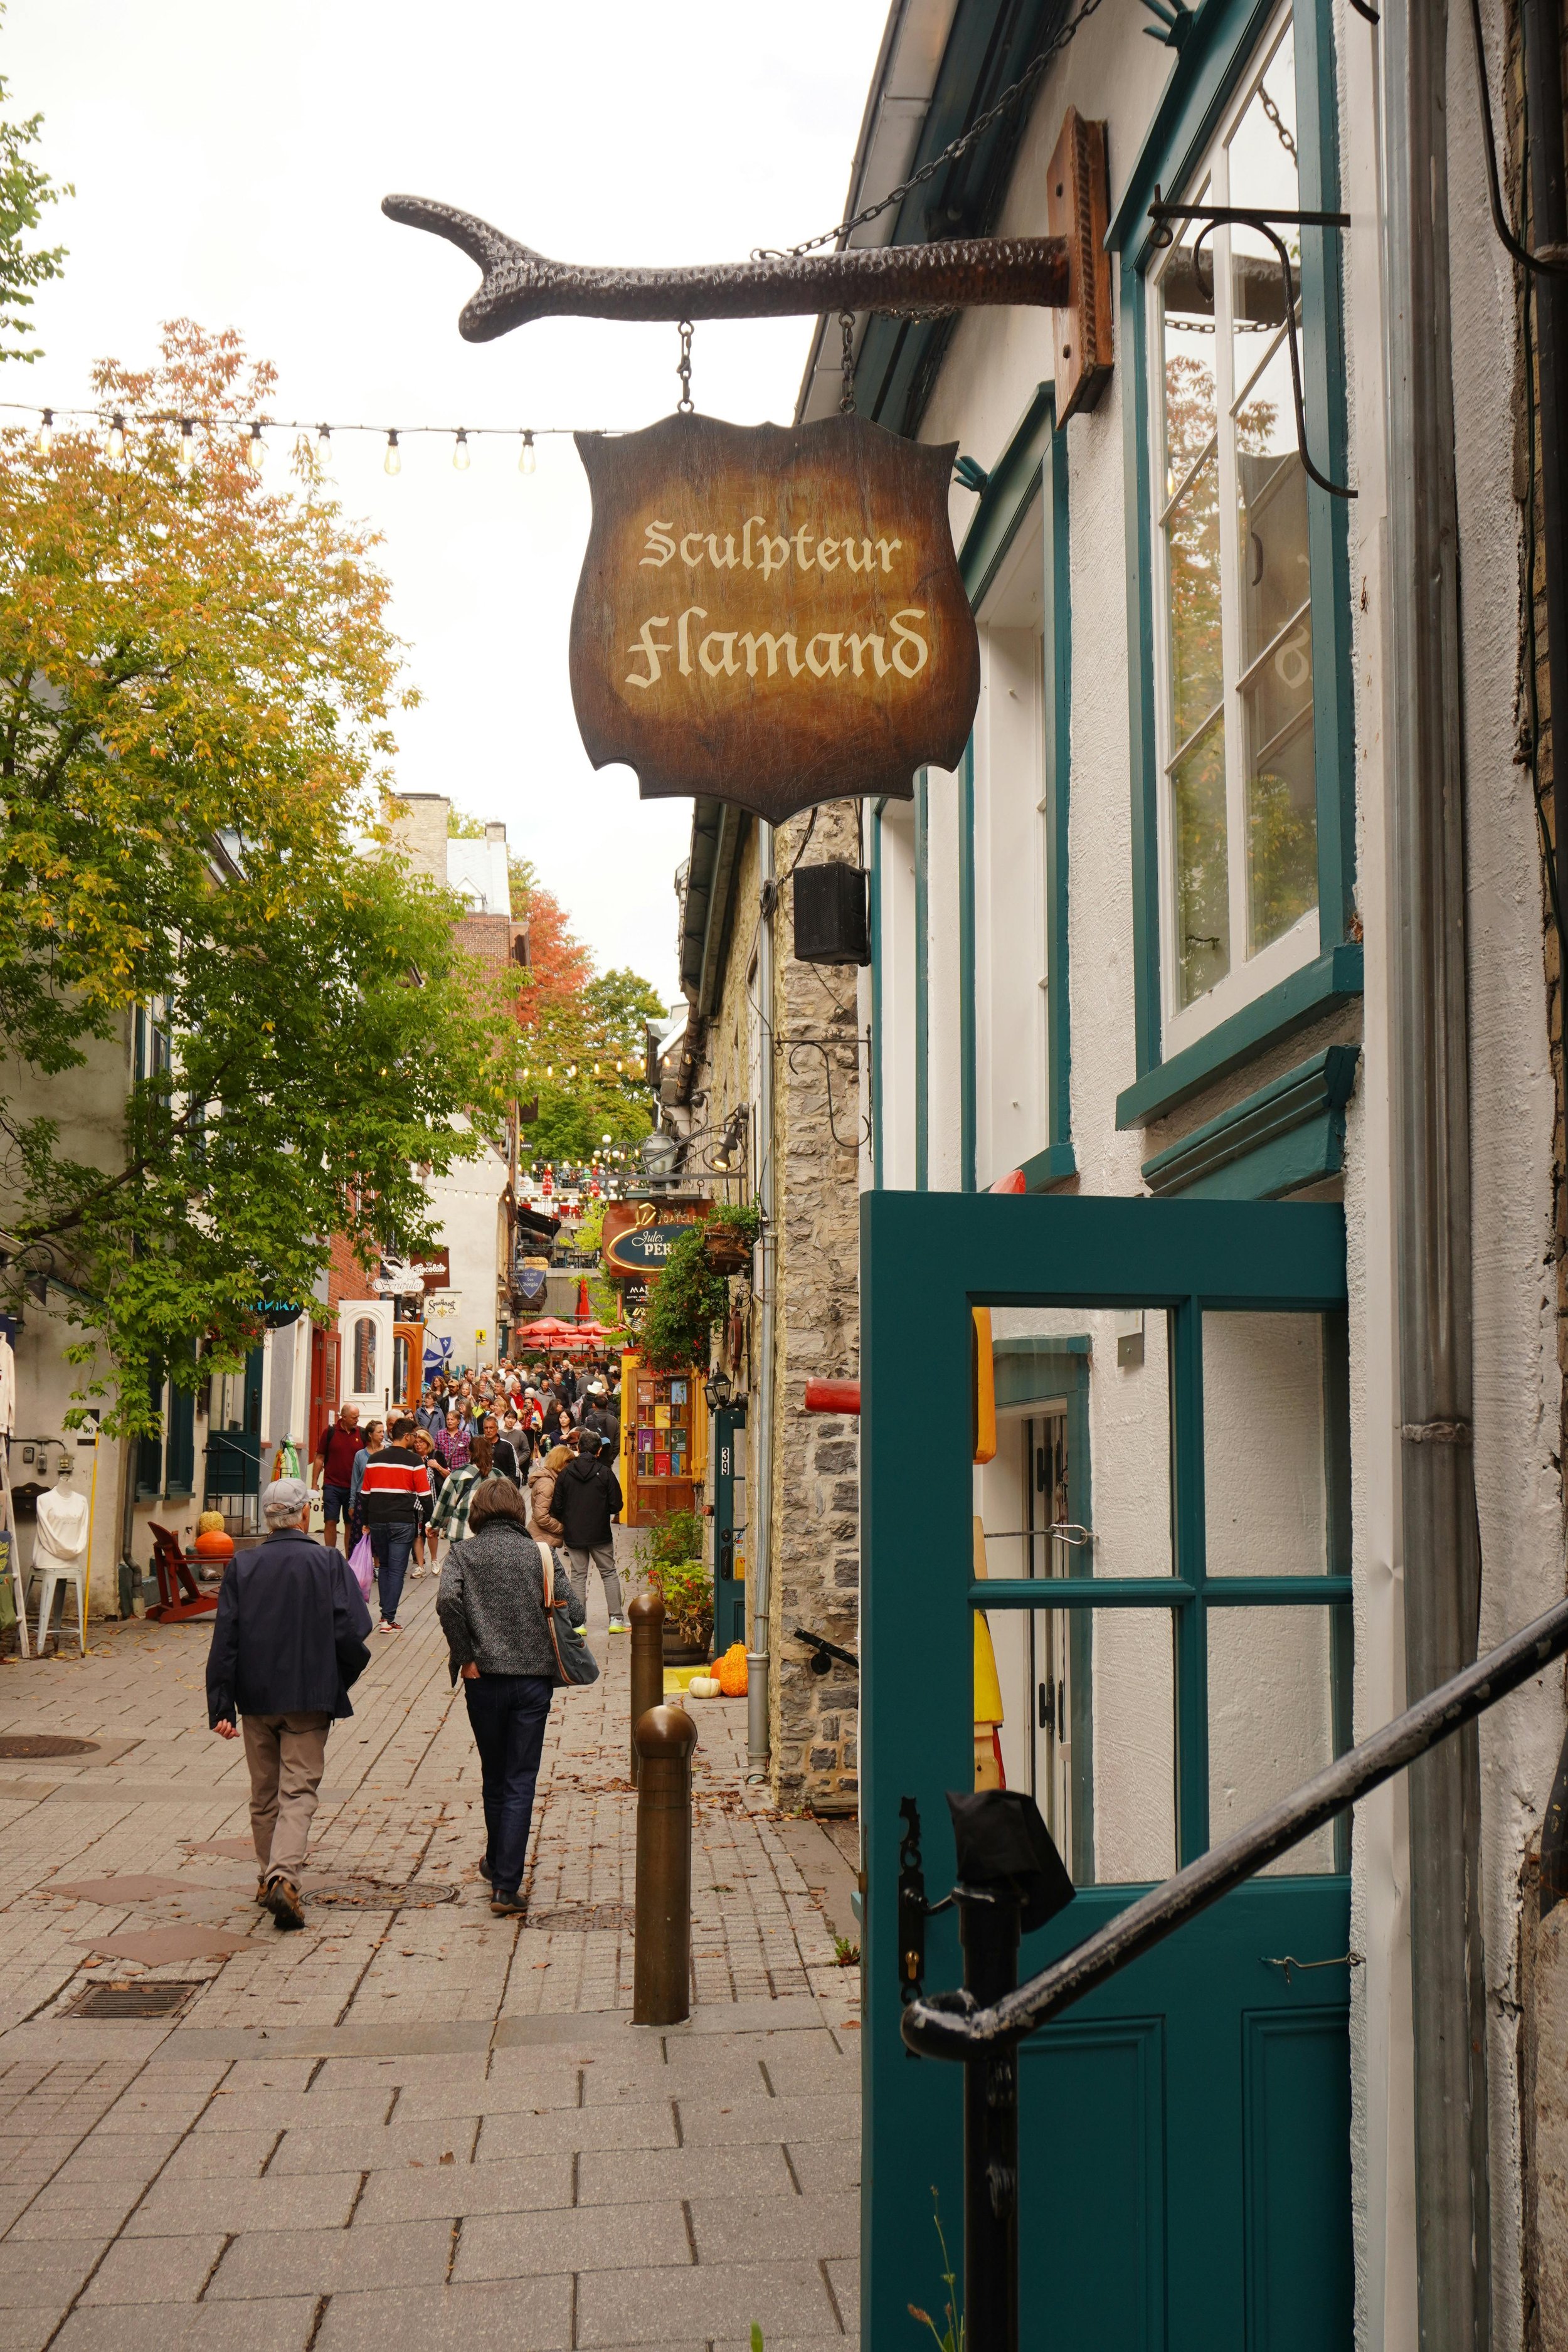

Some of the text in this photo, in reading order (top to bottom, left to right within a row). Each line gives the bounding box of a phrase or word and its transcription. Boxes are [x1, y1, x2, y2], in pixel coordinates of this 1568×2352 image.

[638, 516, 902, 581] Sculpteur
[625, 606, 928, 689] Flamand
[657, 1215, 706, 1224] JOAILLE
[632, 1231, 664, 1246] Jules
[644, 1243, 673, 1255] PER
[374, 1279, 422, 1291] Scrupules
[722, 1448, 728, 1475] 39
